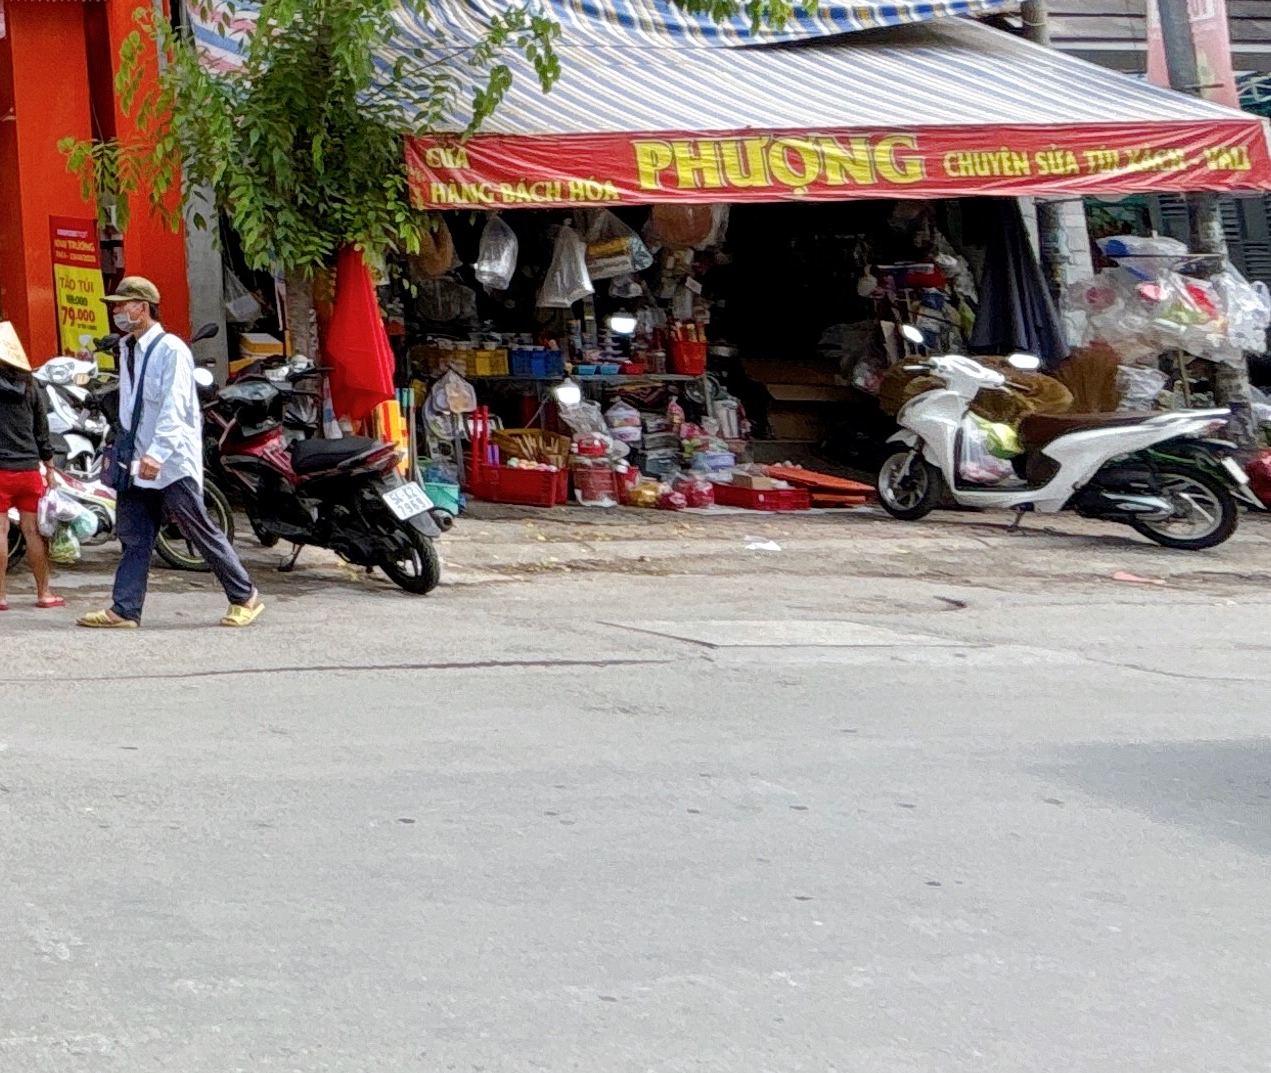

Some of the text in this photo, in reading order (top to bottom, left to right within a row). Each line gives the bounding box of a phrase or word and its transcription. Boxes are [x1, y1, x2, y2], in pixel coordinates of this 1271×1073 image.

[631, 132, 927, 195] PHƯỢNG
[943, 145, 1029, 178] CHUYÊN
[1034, 143, 1081, 176] SỬA
[430, 178, 496, 204] HÀNG
[500, 176, 562, 203] BÁCH
[60, 305, 96, 327] 79.000
